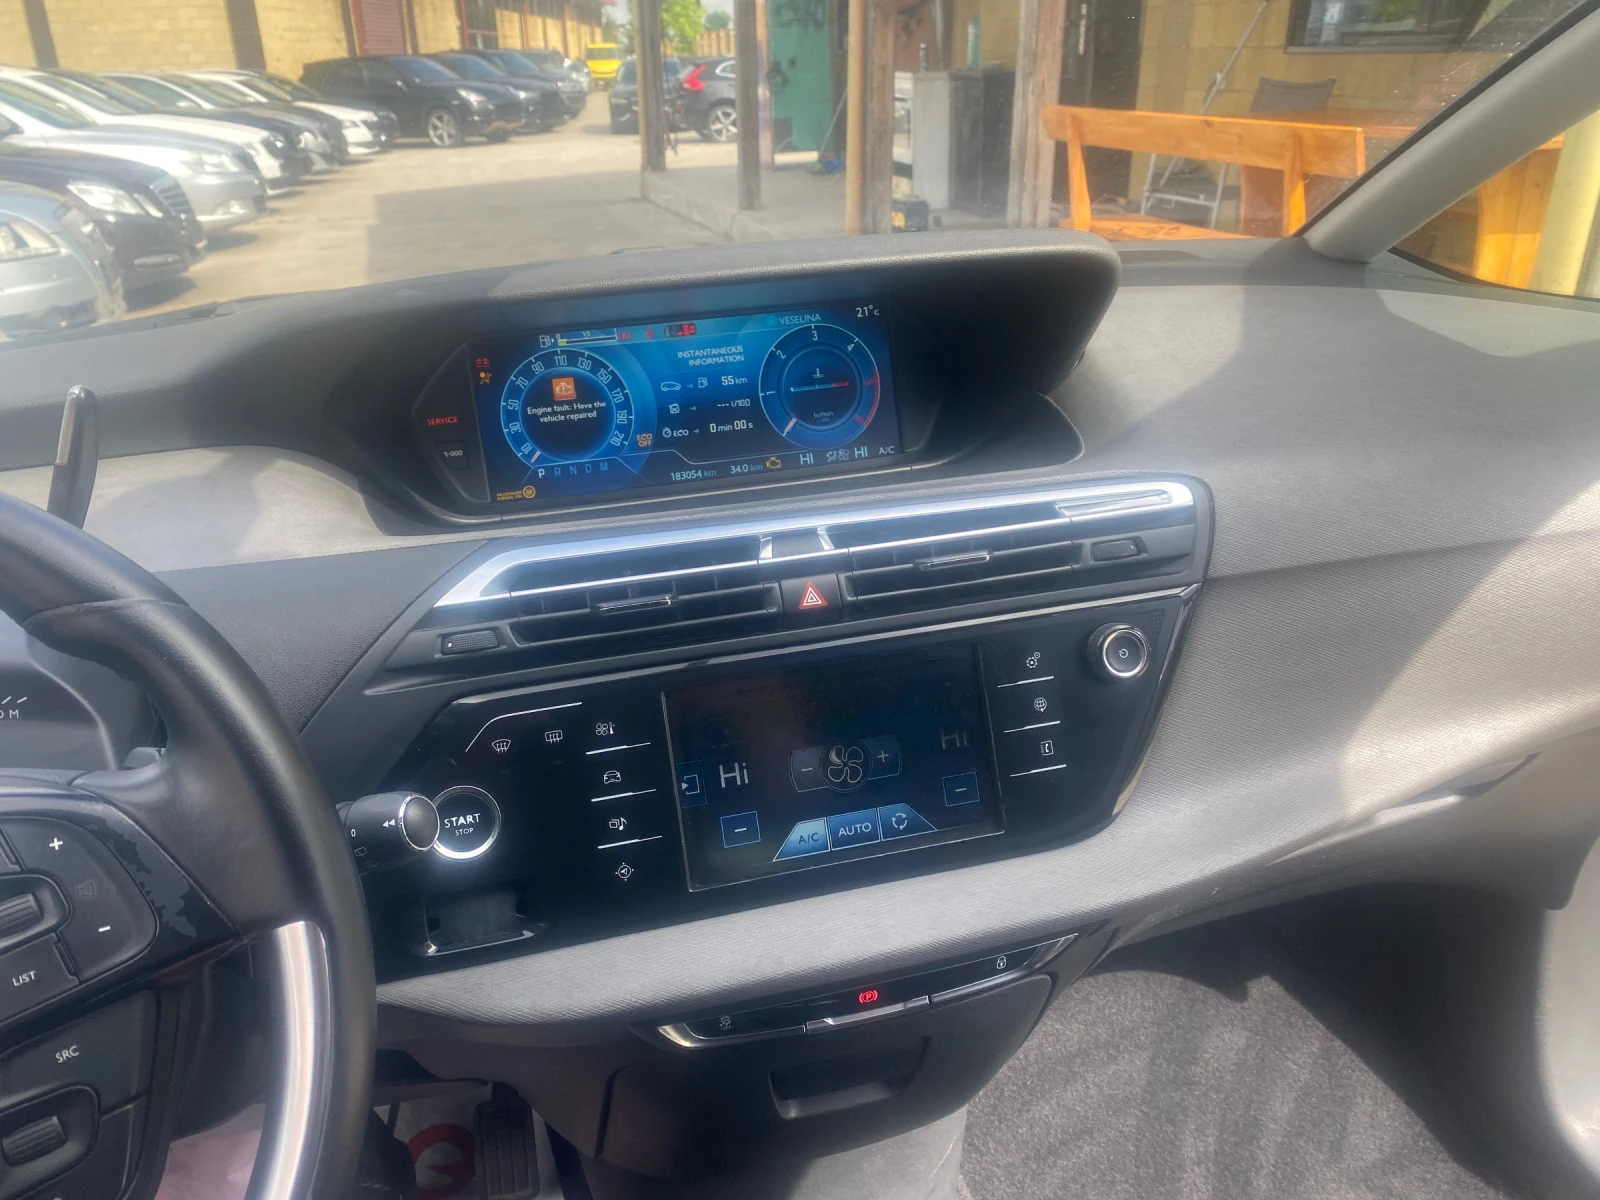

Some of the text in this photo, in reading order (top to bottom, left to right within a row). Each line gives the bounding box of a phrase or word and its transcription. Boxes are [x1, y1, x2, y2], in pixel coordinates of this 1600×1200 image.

[779, 313, 821, 325] VESELINA
[811, 330, 818, 341] 3
[677, 346, 743, 358] INSTANTANEOUS
[847, 343, 855, 352] 4
[554, 355, 567, 366] 110
[688, 355, 744, 367] INFORMATION
[776, 350, 786, 359] 2
[531, 361, 544, 375] 90
[577, 357, 592, 371] 130
[515, 376, 528, 390] 70
[596, 368, 612, 385] 150
[721, 376, 748, 385] 55 km
[611, 388, 624, 403] 170
[507, 399, 520, 411] 50
[527, 400, 606, 416] Engine fault: Have the
[427, 416, 458, 426] SERVICE
[539, 410, 597, 423] vehicle repaired
[616, 409, 627, 424] 190
[508, 421, 521, 434] 30
[673, 429, 689, 437] ECO
[710, 423, 716, 432] 0
[717, 424, 732, 432] min
[734, 420, 747, 430] 00
[609, 430, 624, 447] 210
[636, 433, 652, 441] ECO
[520, 442, 533, 455] 10
[854, 446, 868, 459] HI
[879, 446, 895, 455] A/C
[800, 452, 814, 465] HI
[537, 468, 545, 479] P
[569, 465, 577, 475] N
[585, 463, 592, 473] D
[600, 462, 608, 472] M
[670, 470, 702, 481] 183054
[703, 469, 716, 477] km
[730, 464, 748, 474] 34.0
[718, 762, 749, 788] Hi
[444, 813, 481, 828] START
[455, 827, 474, 836] STOP
[838, 822, 872, 837] AUTO
[798, 832, 820, 844] A/C
[12, 970, 37, 987] LIST
[55, 1045, 80, 1064] SRC
